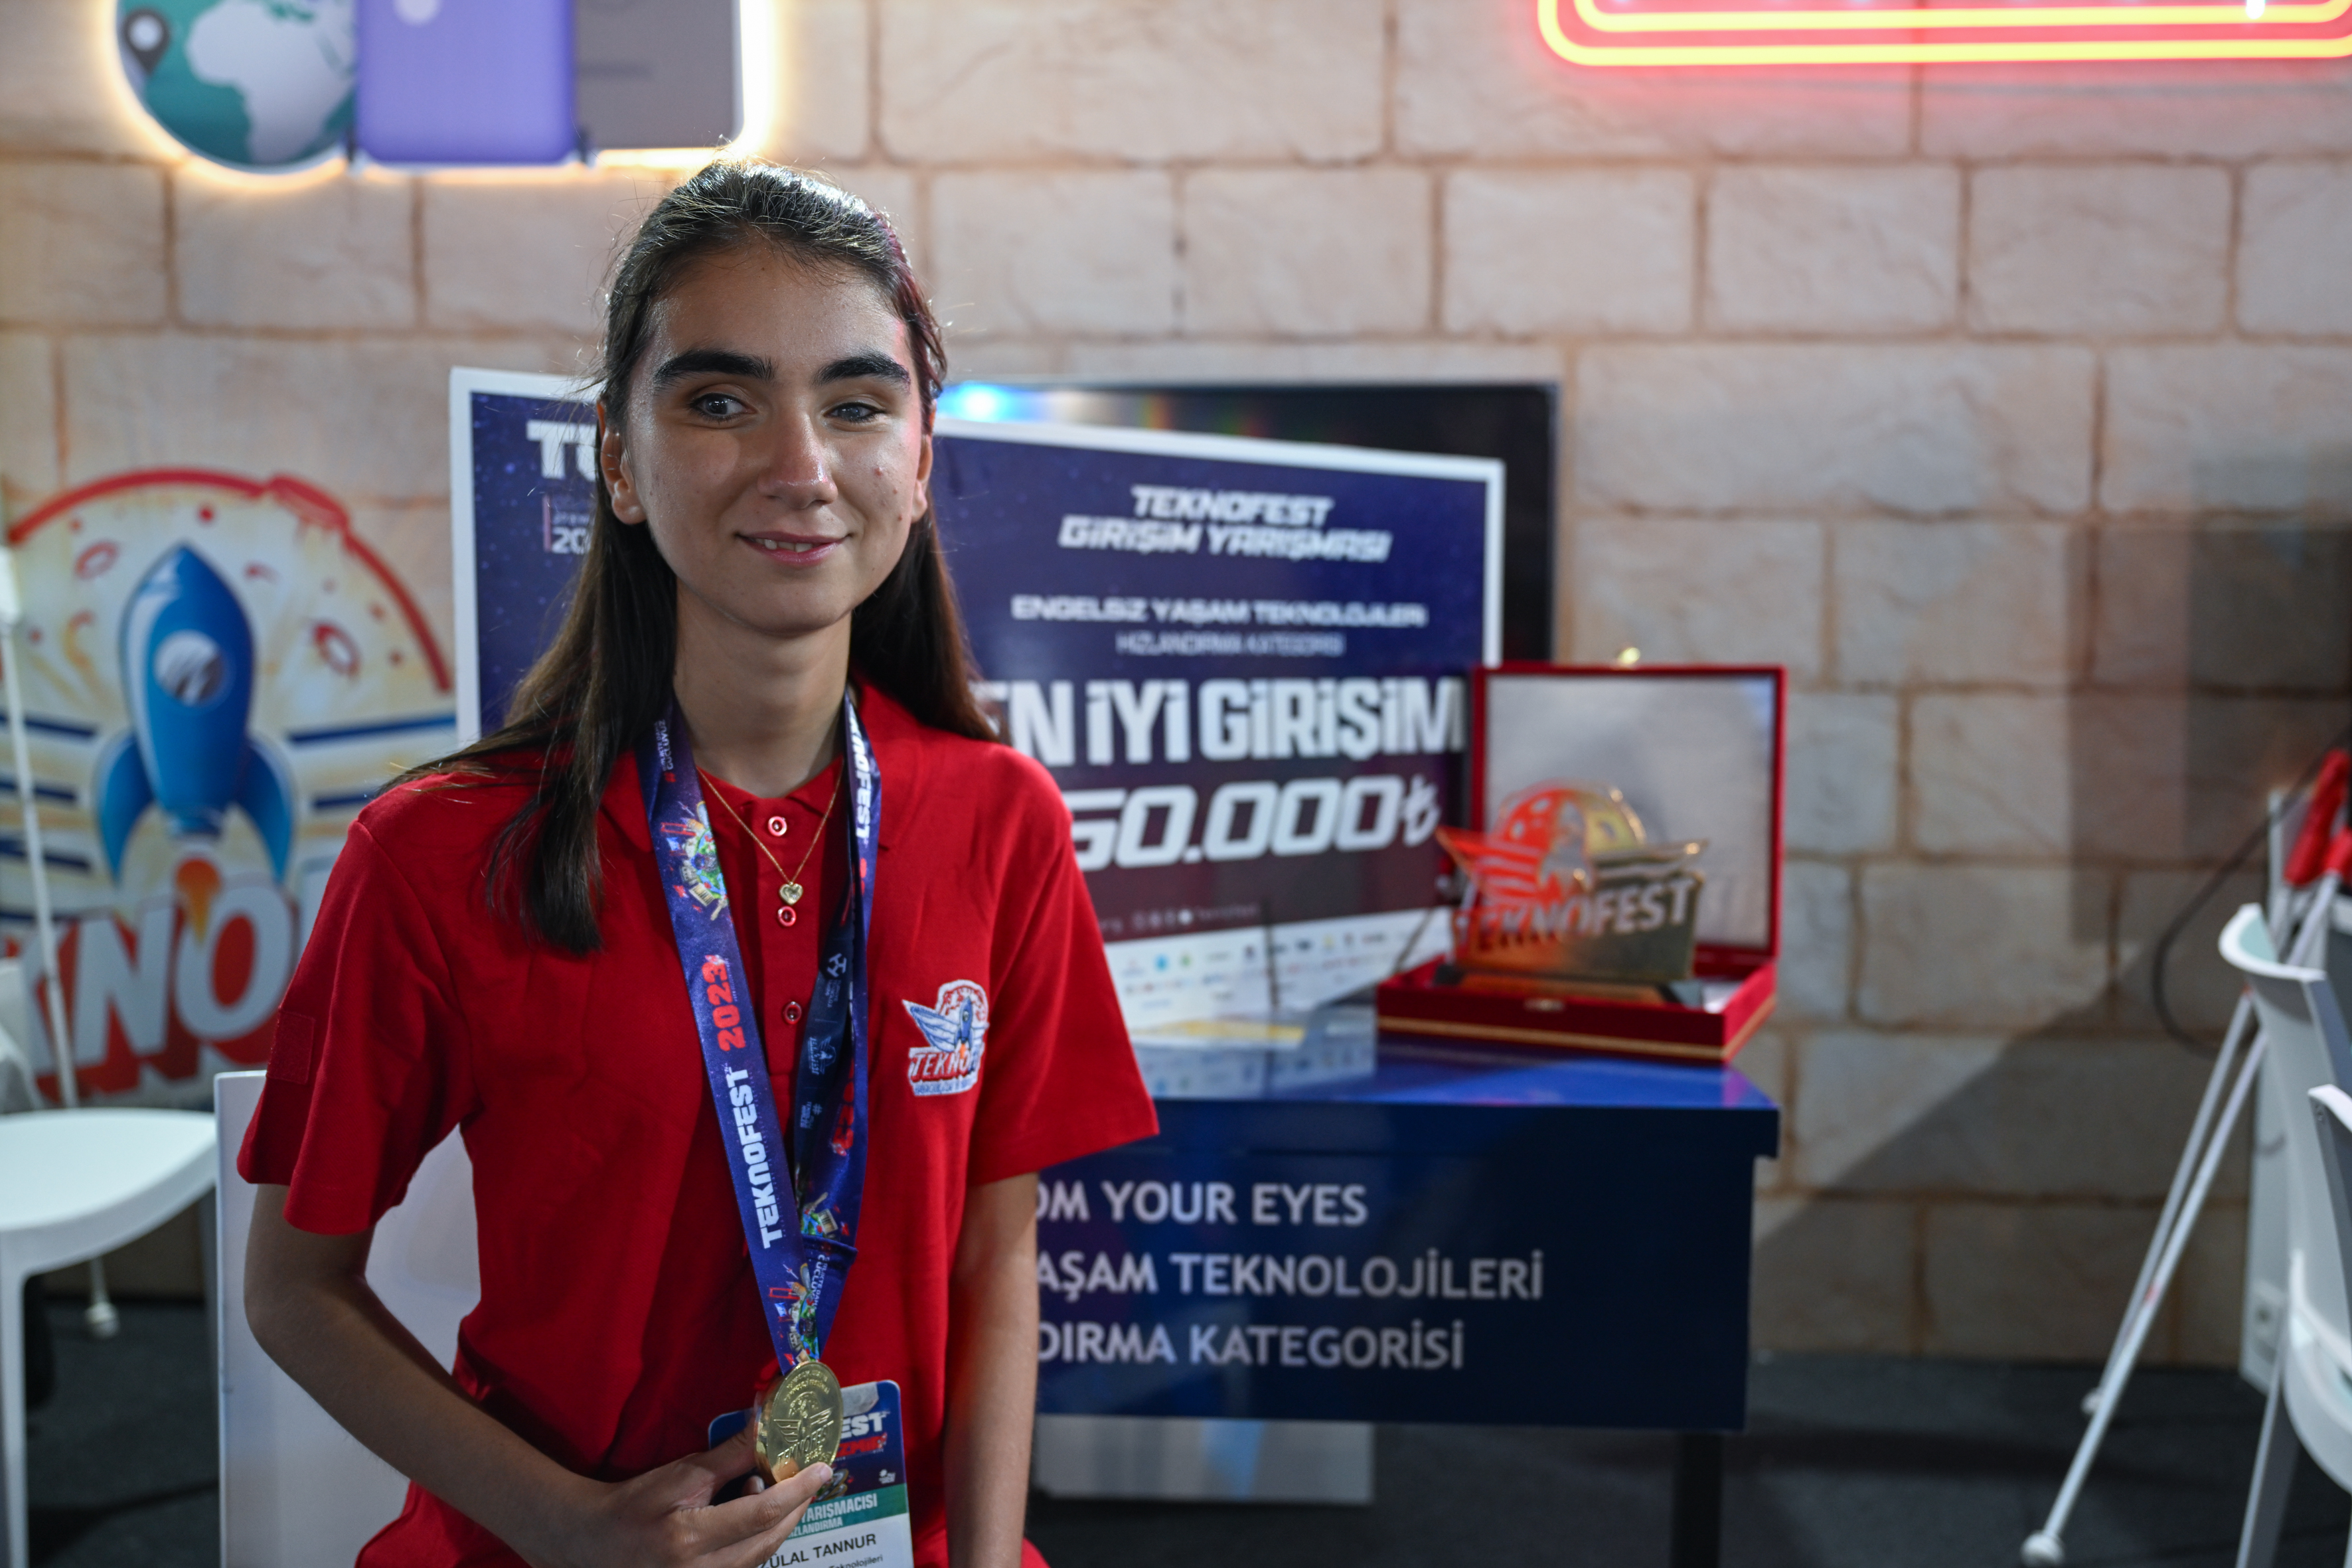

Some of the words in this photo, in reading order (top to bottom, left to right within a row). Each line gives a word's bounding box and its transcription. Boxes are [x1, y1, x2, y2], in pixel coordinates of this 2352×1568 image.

[1131, 485, 1334, 526] TEKNOFEST
[849, 704, 871, 838] KNOFEST
[702, 961, 746, 1052] 2023
[726, 1067, 783, 1249] TEKNOFEST
[1101, 1180, 1238, 1225] YOUR
[1251, 1184, 1368, 1226] EYES
[1168, 1248, 1544, 1299] TEKNOLOJİLERİ
[1188, 1318, 1465, 1370] KATEGORİSİ
[813, 1533, 876, 1558] TANNUR
